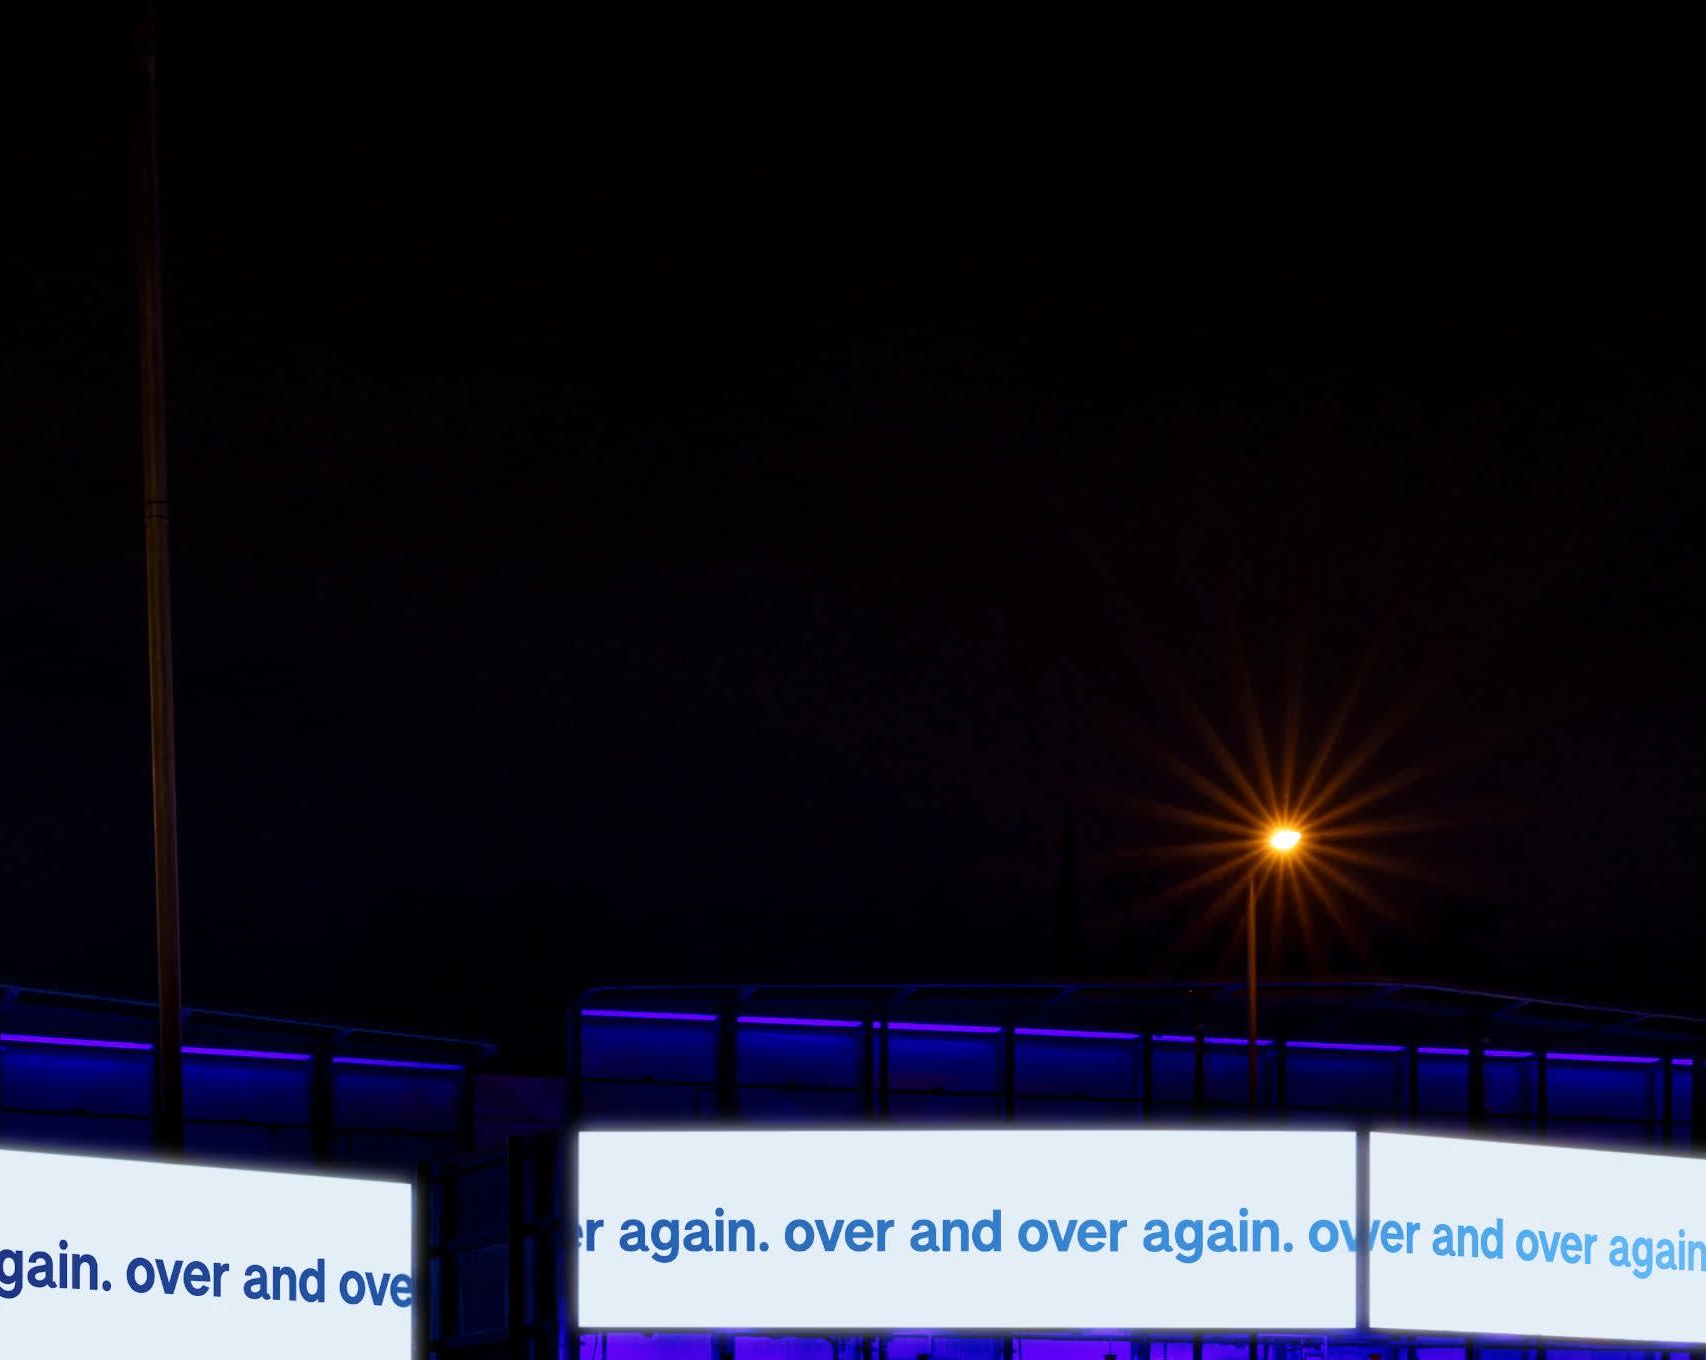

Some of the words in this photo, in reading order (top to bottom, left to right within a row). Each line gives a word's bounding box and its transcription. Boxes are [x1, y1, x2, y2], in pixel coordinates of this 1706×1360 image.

[619, 1207, 769, 1264] again.
[785, 1219, 895, 1253] over
[910, 1209, 1001, 1253] and
[1018, 1219, 1127, 1253] over
[1143, 1207, 1293, 1265] again.
[1432, 1218, 1503, 1259] and
[1516, 1228, 1597, 1264] over
[126, 1257, 229, 1297] over
[243, 1258, 325, 1303] and
